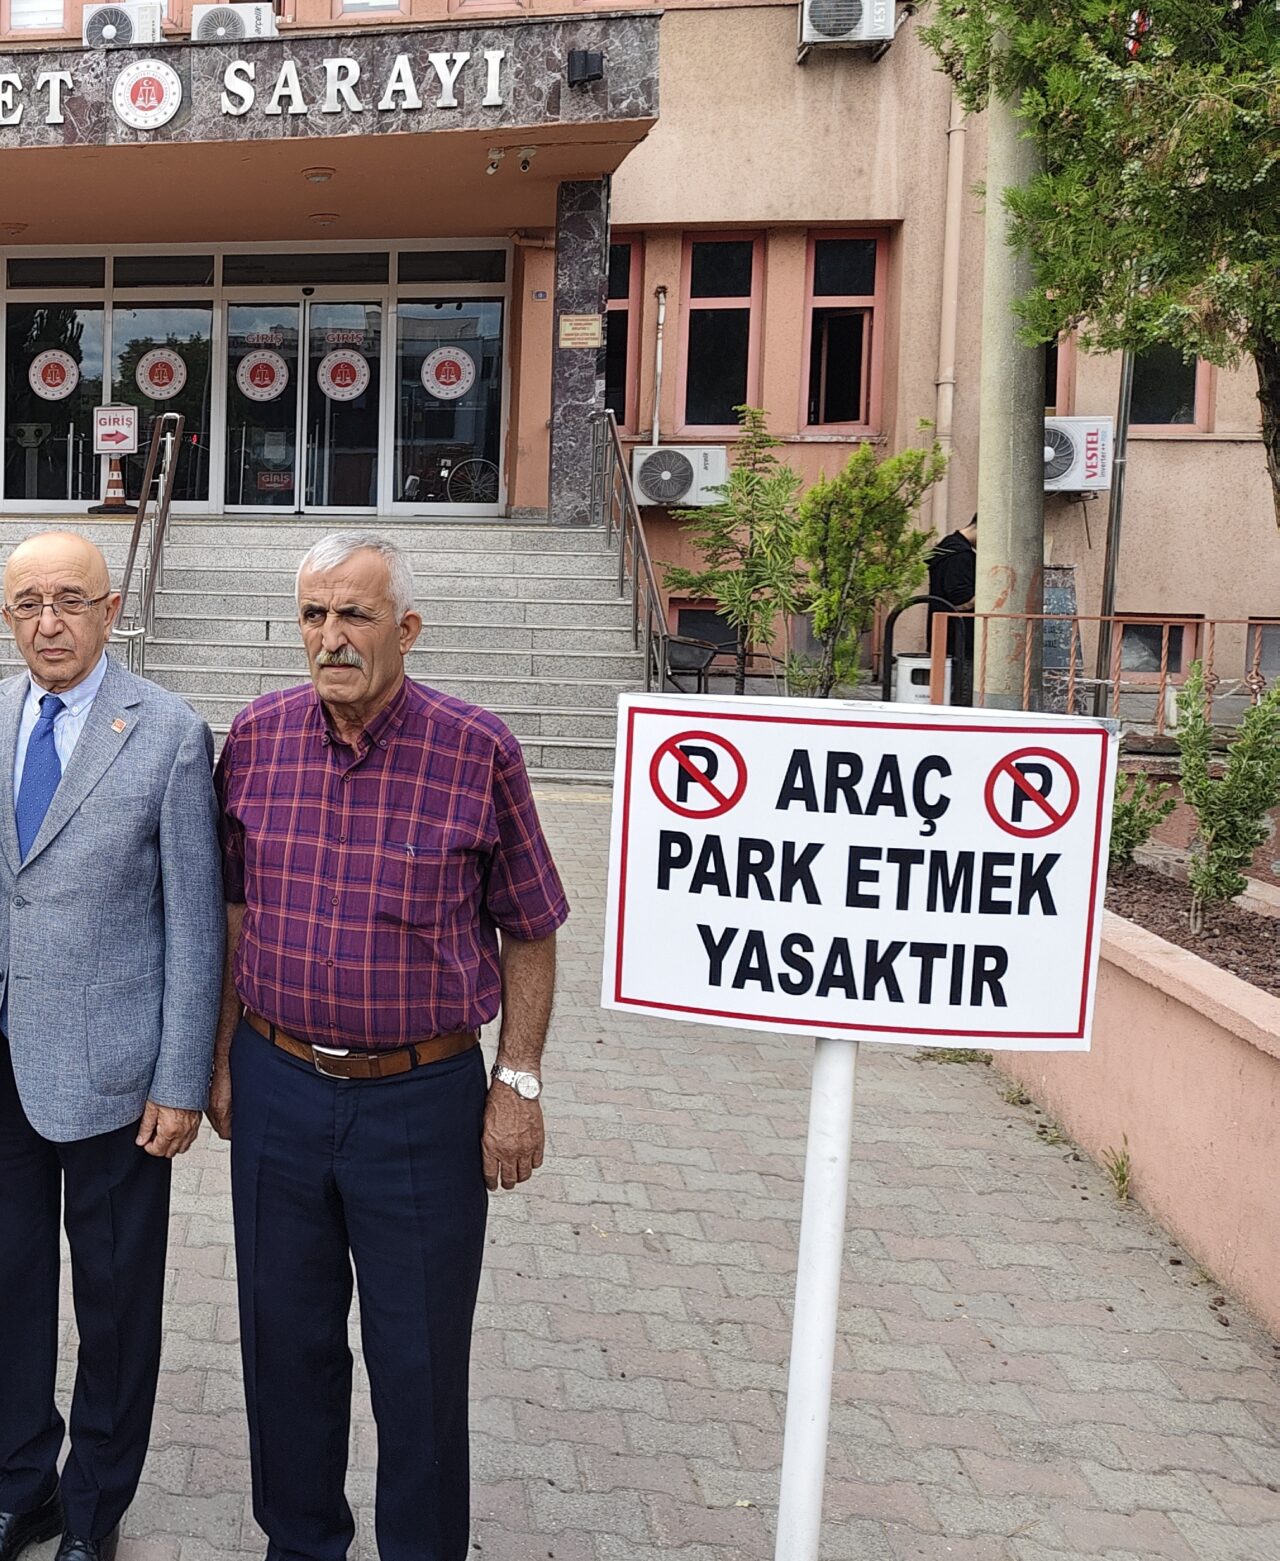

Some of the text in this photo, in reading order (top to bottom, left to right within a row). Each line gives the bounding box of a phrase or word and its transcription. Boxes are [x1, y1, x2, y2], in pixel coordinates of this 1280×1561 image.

[254, 5, 263, 35] arçelik
[220, 50, 505, 116] SARAYI
[99, 415, 133, 428] GİRİŞ
[261, 472, 290, 484] GİRİŞ
[1085, 428, 1099, 480] VESTEL
[775, 748, 952, 837] ARAÇ
[656, 829, 1062, 917] PARK ETMEK
[696, 923, 1009, 1008] YASAKTIR
